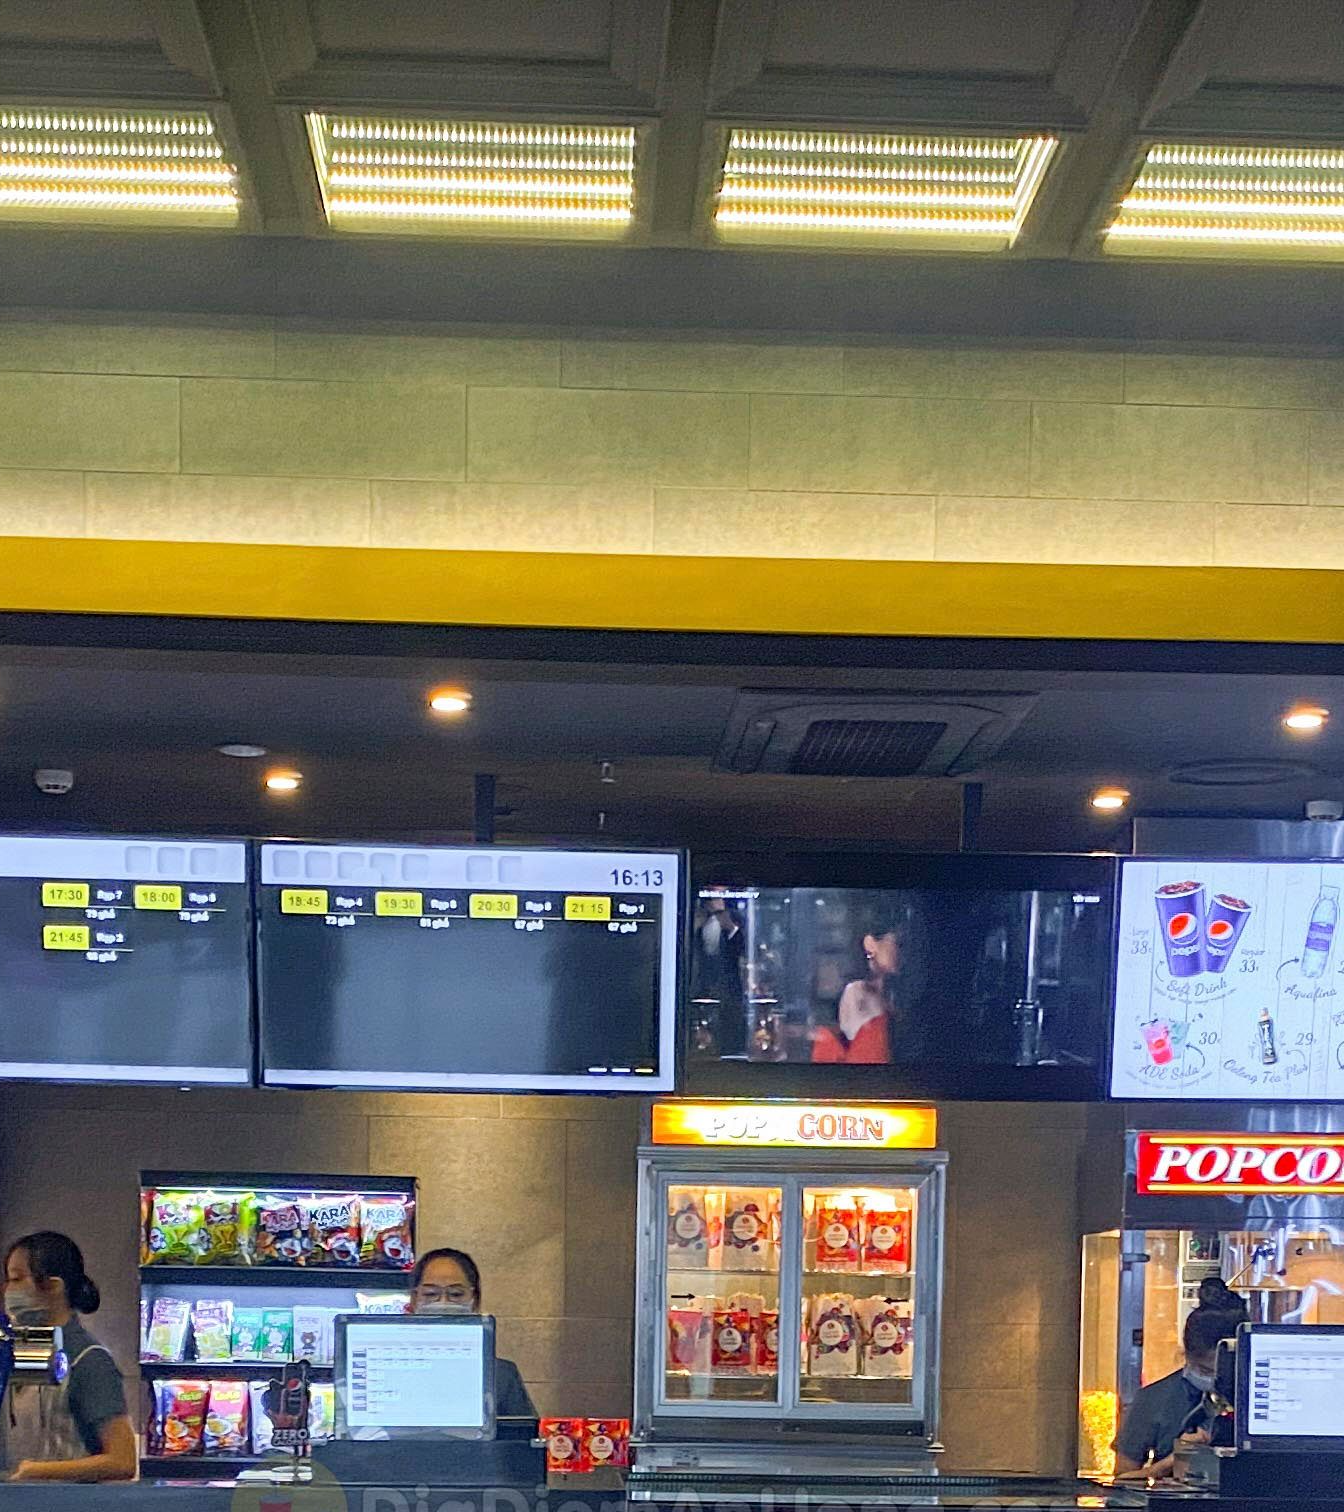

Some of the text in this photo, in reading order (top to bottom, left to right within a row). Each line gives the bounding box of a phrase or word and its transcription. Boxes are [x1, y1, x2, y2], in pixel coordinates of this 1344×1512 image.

[610, 868, 663, 886] 16:13
[49, 889, 83, 900] 17:30
[142, 891, 176, 903] 18:00
[50, 931, 83, 942] 21:45
[1195, 976, 1228, 997] Drink
[797, 1113, 884, 1141] CORN
[309, 1205, 350, 1222] KARA
[366, 1207, 405, 1220] KARA
[274, 1429, 308, 1440] ZERO
